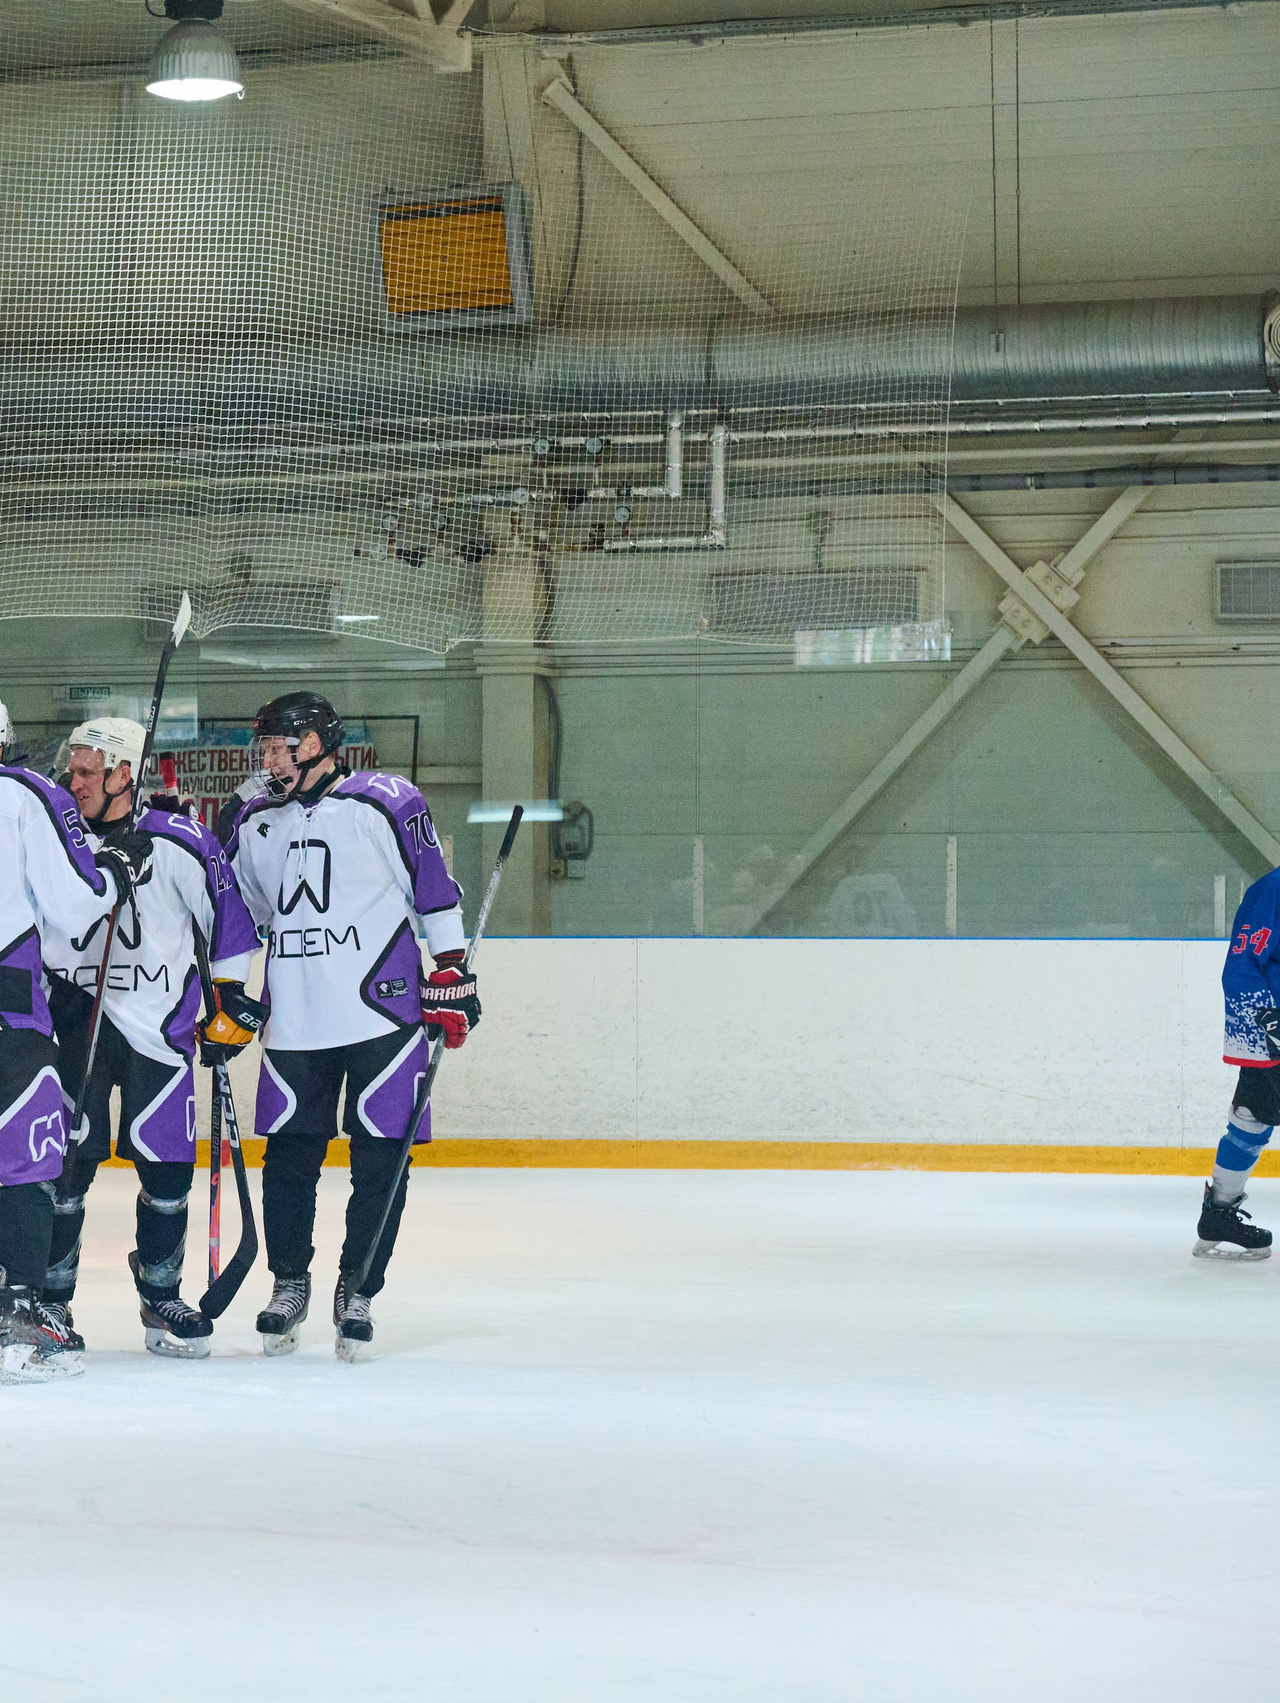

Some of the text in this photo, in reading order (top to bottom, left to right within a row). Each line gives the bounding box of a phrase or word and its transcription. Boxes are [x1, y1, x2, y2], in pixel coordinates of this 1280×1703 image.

[71, 688, 110, 699] ВЫХОД
[404, 810, 438, 855] 70
[1232, 924, 1272, 955] 54
